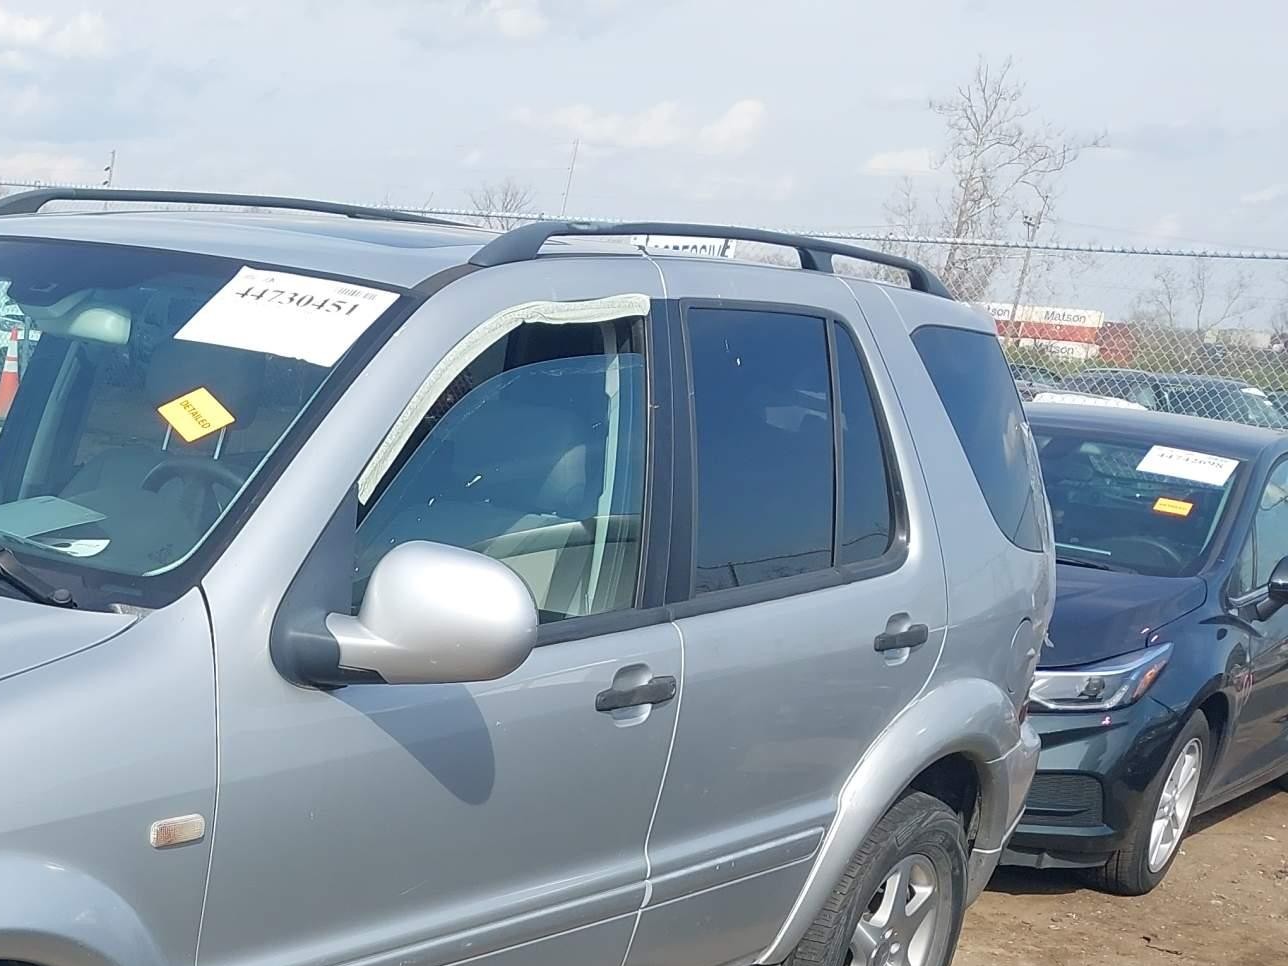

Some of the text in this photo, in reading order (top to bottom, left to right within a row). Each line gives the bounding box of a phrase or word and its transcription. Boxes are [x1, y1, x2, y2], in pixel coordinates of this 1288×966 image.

[235, 286, 360, 316] 44730451
[1044, 310, 1086, 324] Matson
[179, 399, 211, 429] DETAILED
